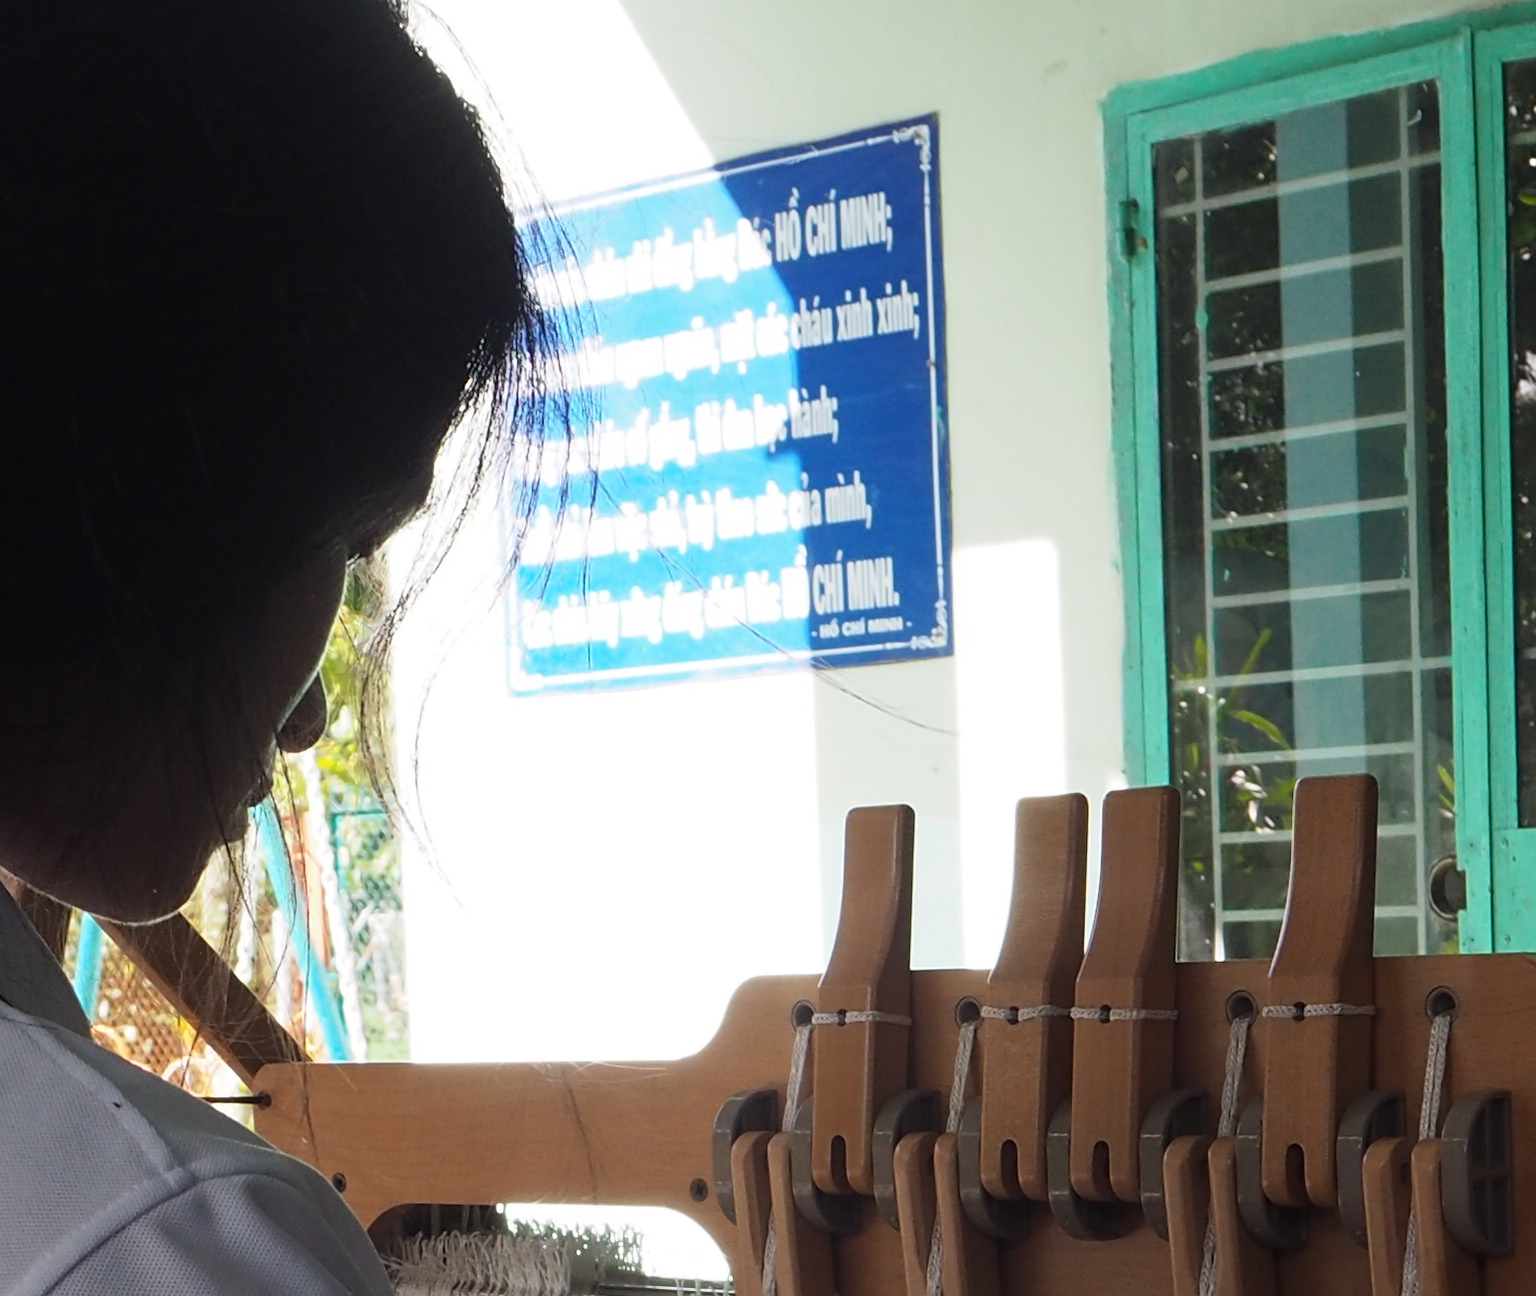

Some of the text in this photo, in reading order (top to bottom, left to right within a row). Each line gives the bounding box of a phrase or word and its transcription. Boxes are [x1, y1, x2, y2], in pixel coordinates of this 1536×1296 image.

[775, 187, 802, 263] HỒ
[805, 188, 838, 258] CHÍ
[840, 191, 893, 253] MINH;
[791, 295, 834, 349] cháu
[836, 287, 874, 342] xinh
[876, 279, 920, 340] xinh;
[825, 470, 872, 530] mình,
[814, 549, 844, 615] CHÍ
[847, 556, 900, 611] MINH.
[867, 616, 903, 634] MINH
